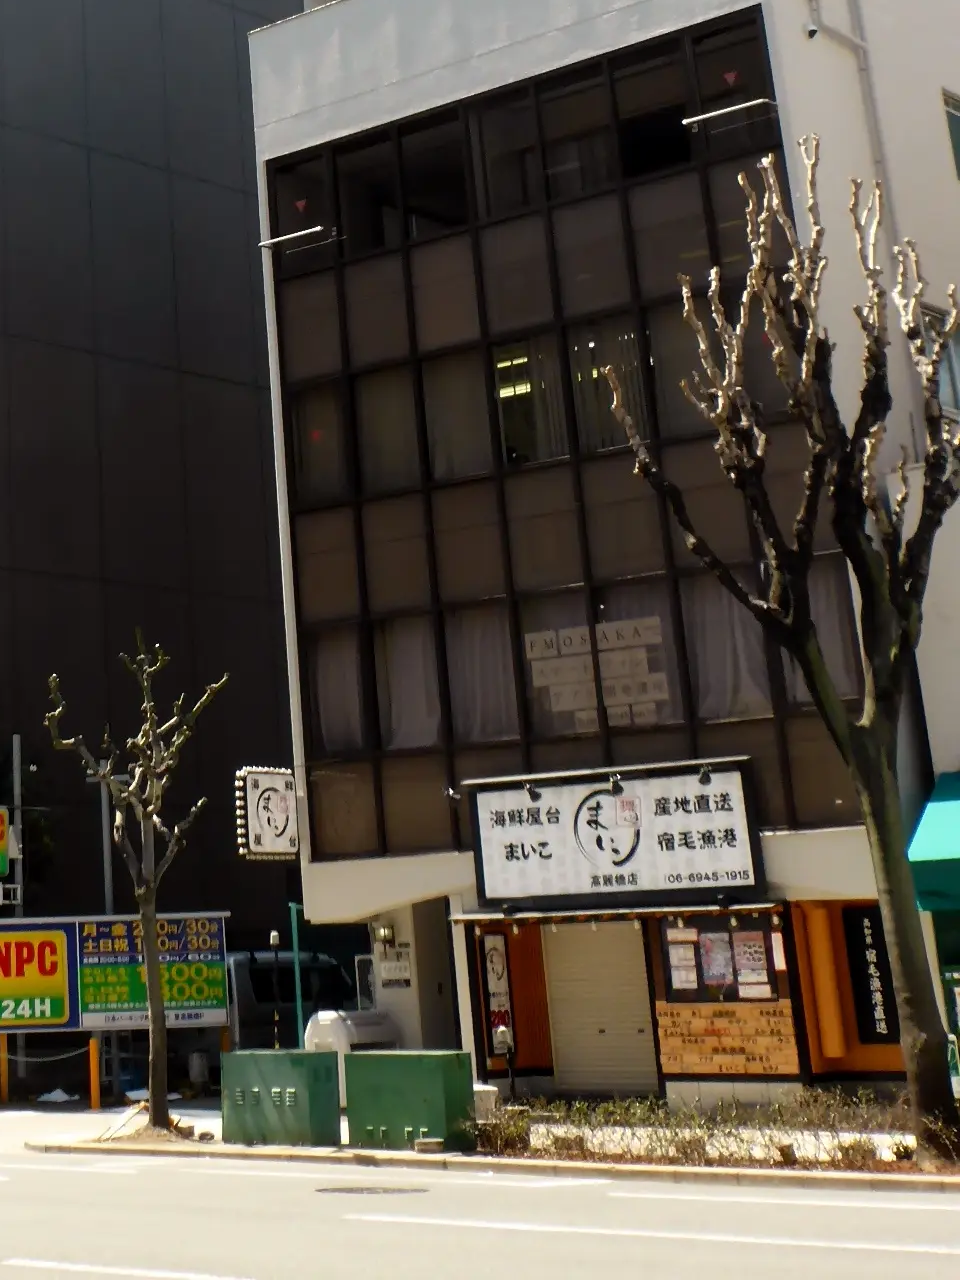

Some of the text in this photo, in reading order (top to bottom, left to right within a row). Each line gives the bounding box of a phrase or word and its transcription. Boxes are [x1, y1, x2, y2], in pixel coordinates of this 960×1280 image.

[654, 793, 734, 816] 産地直送
[489, 806, 561, 828] 海鮮屋台
[657, 828, 738, 851] 宿毛漁港
[504, 842, 553, 861] まいこ
[1, 997, 52, 1019] 24H
